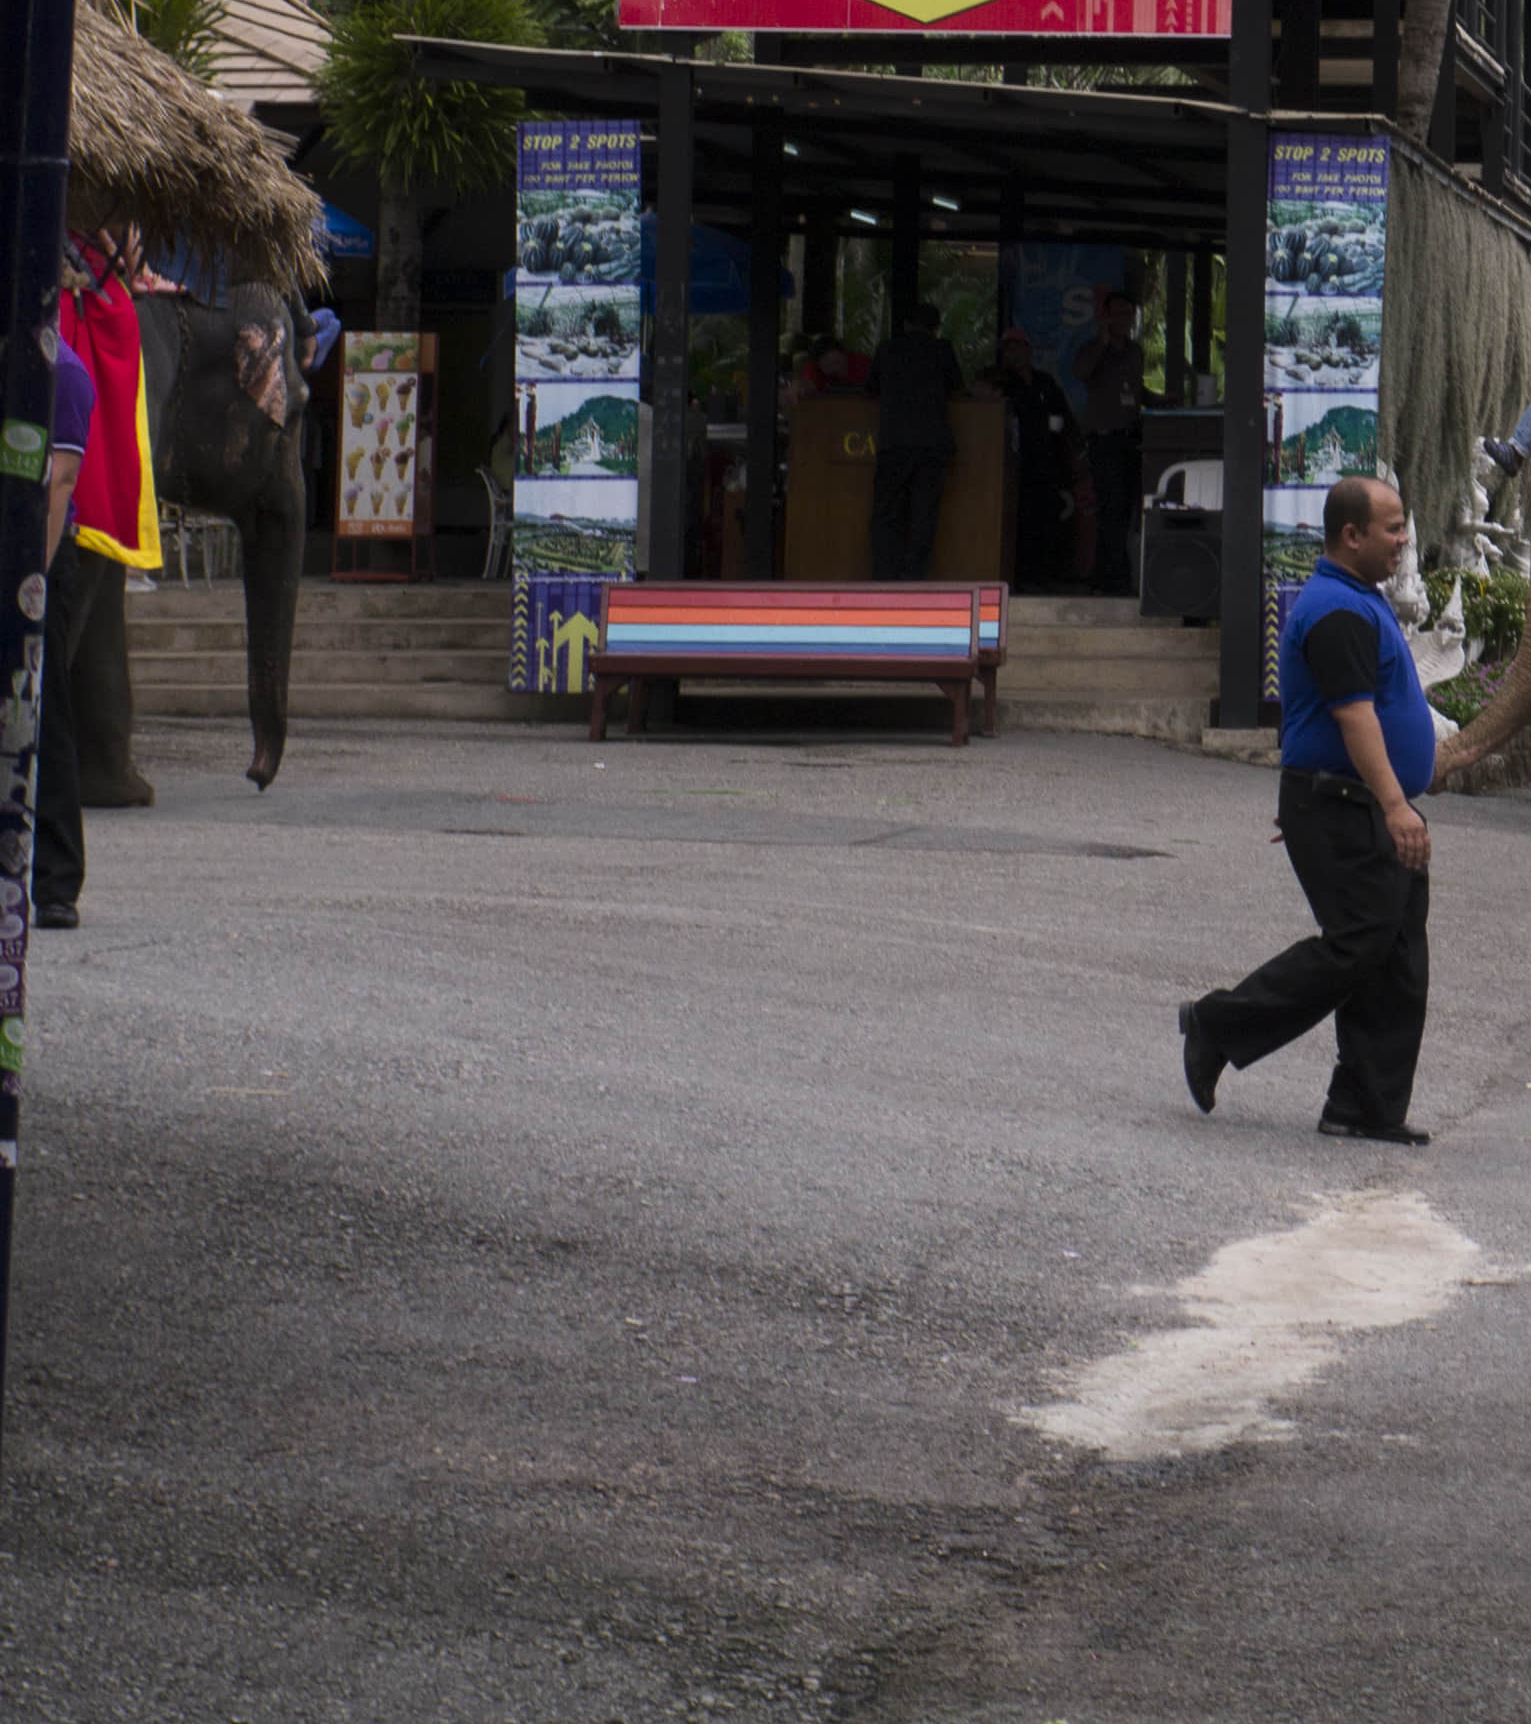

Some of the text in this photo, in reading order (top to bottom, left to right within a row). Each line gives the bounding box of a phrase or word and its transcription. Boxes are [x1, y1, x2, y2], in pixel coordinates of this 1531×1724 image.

[523, 133, 636, 151] STOP 2 SPOTS
[1275, 145, 1386, 164] STOP 2 SPOTS
